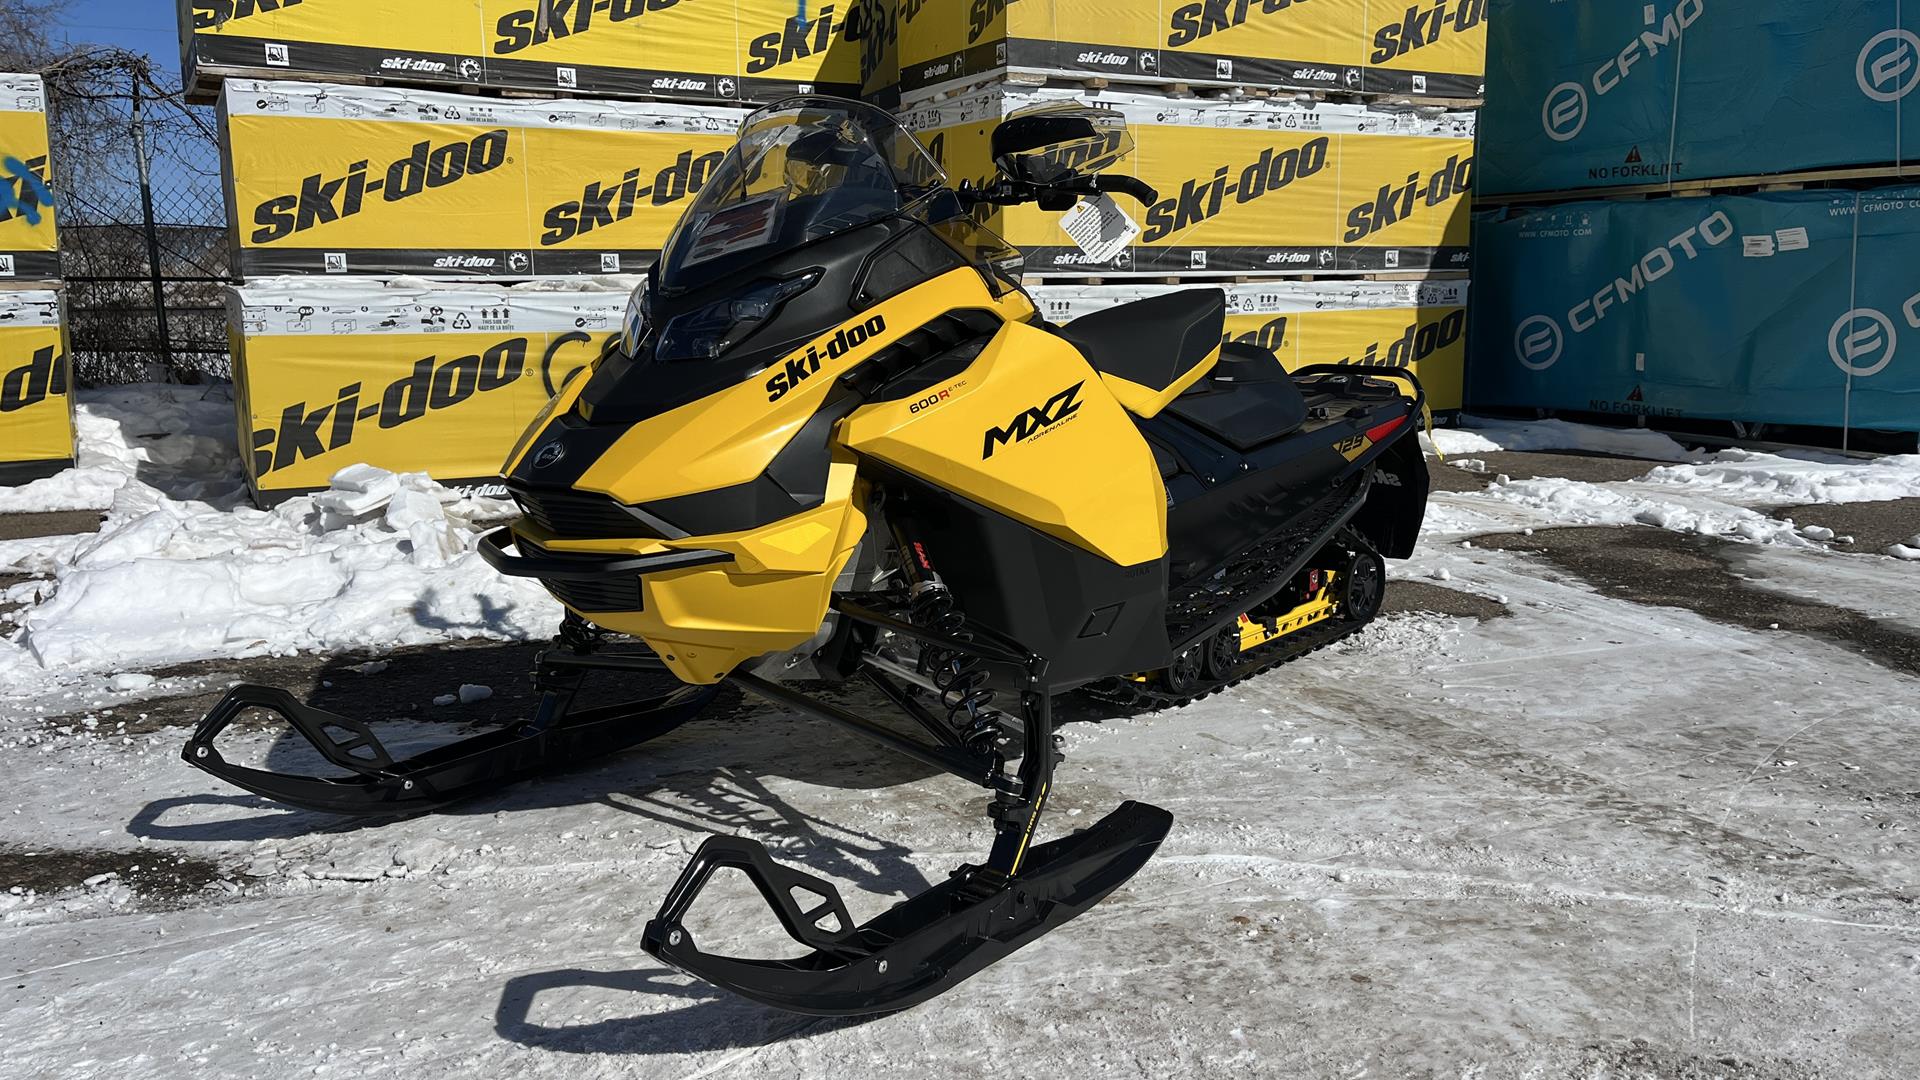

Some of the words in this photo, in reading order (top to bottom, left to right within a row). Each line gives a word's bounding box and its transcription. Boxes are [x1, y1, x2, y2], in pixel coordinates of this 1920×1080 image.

[380, 56, 446, 72] ski-doo
[1077, 51, 1129, 66] ski-doo
[651, 77, 706, 91] ski-doo
[1293, 69, 1336, 81] ski-doo
[251, 130, 508, 243] ski-doo
[1143, 137, 1328, 243] ski-doo
[433, 255, 495, 267] ski-doo
[1266, 253, 1310, 263] ski-doo
[1568, 210, 1733, 333] CFMOTO
[766, 315, 886, 402] ski-doo
[982, 379, 1086, 461] MXZ
[1027, 413, 1078, 444] ADRENALINE
